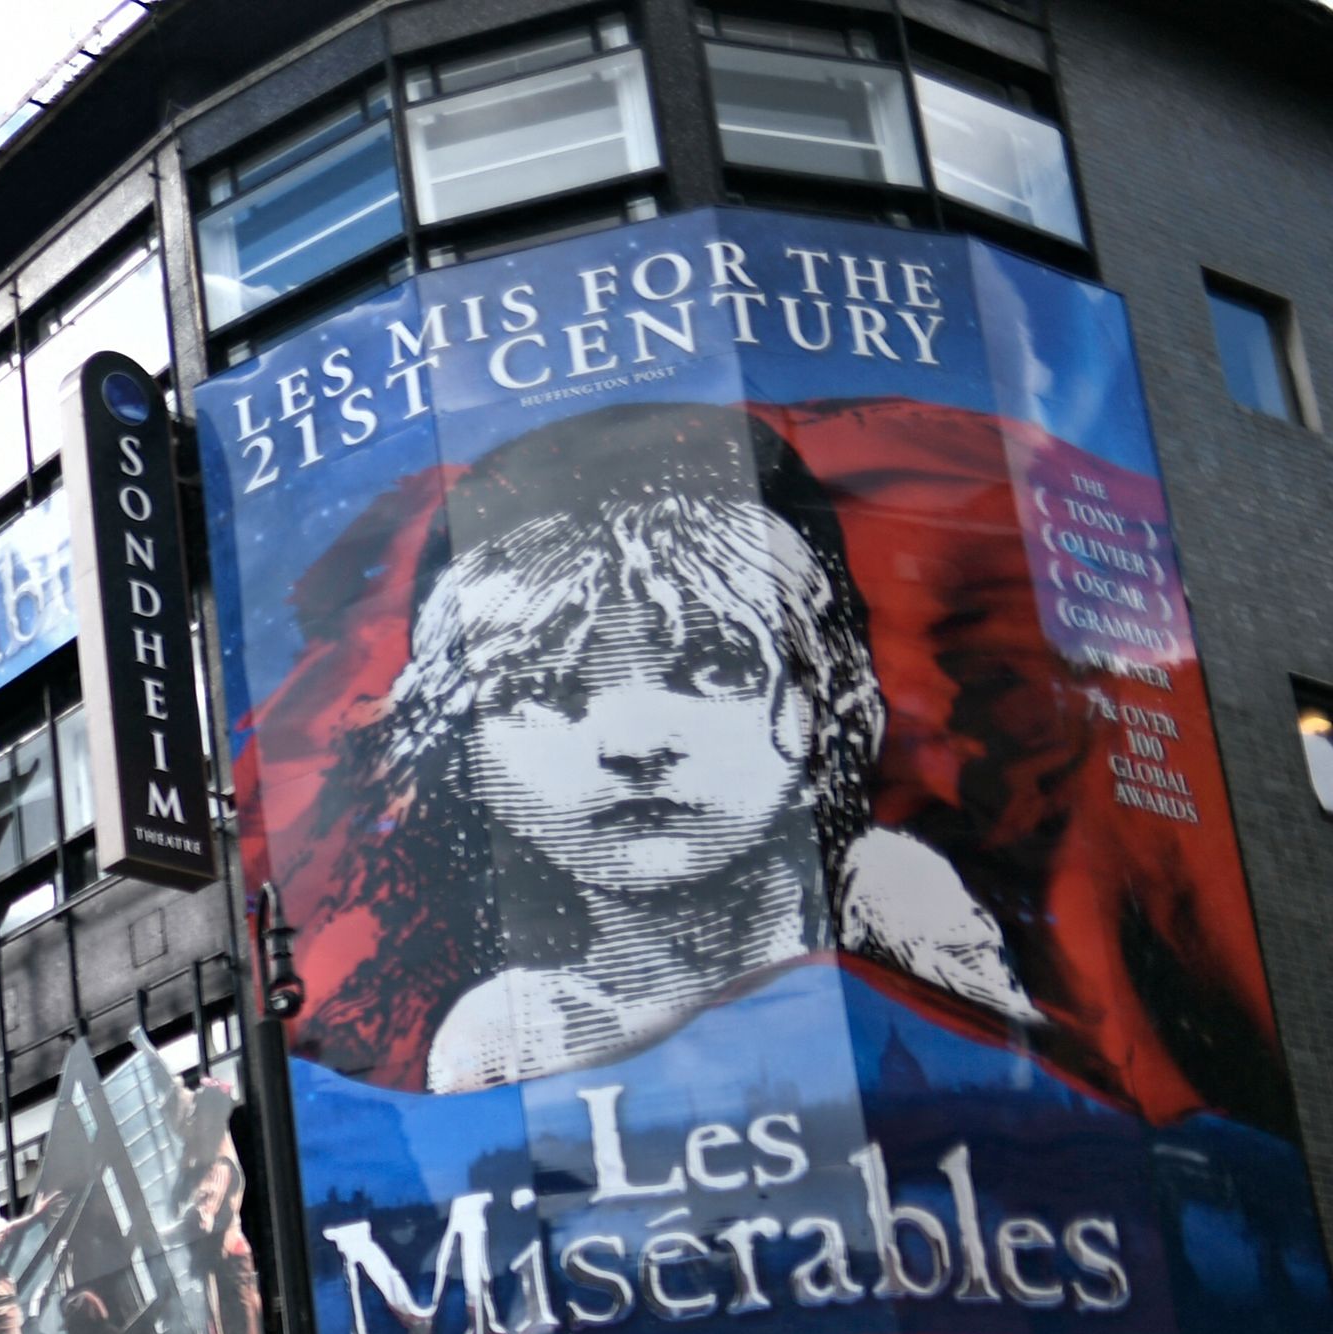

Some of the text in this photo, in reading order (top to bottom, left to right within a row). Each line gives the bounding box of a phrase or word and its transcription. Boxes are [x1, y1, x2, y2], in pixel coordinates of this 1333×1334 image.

[233, 240, 943, 443] LES MIS FOR THE
[241, 291, 945, 495] 21ST CENTURY
[520, 366, 677, 408] HUFFINGTON POST
[1071, 473, 1108, 500] THE
[1063, 498, 1127, 538] TONY
[1059, 530, 1149, 578] OLIVIER
[1073, 571, 1147, 613] OSCAR
[118, 436, 186, 825] SONDHEIM
[1067, 603, 1169, 654] GRAMMY
[1083, 644, 1173, 692] WINNER
[1121, 703, 1180, 740] OVER
[1128, 730, 1164, 762] 100
[1108, 754, 1192, 796] GLOBAL
[1115, 783, 1199, 824] AWARDS
[133, 825, 204, 856] THEATRE
[576, 1084, 811, 1203] Les
